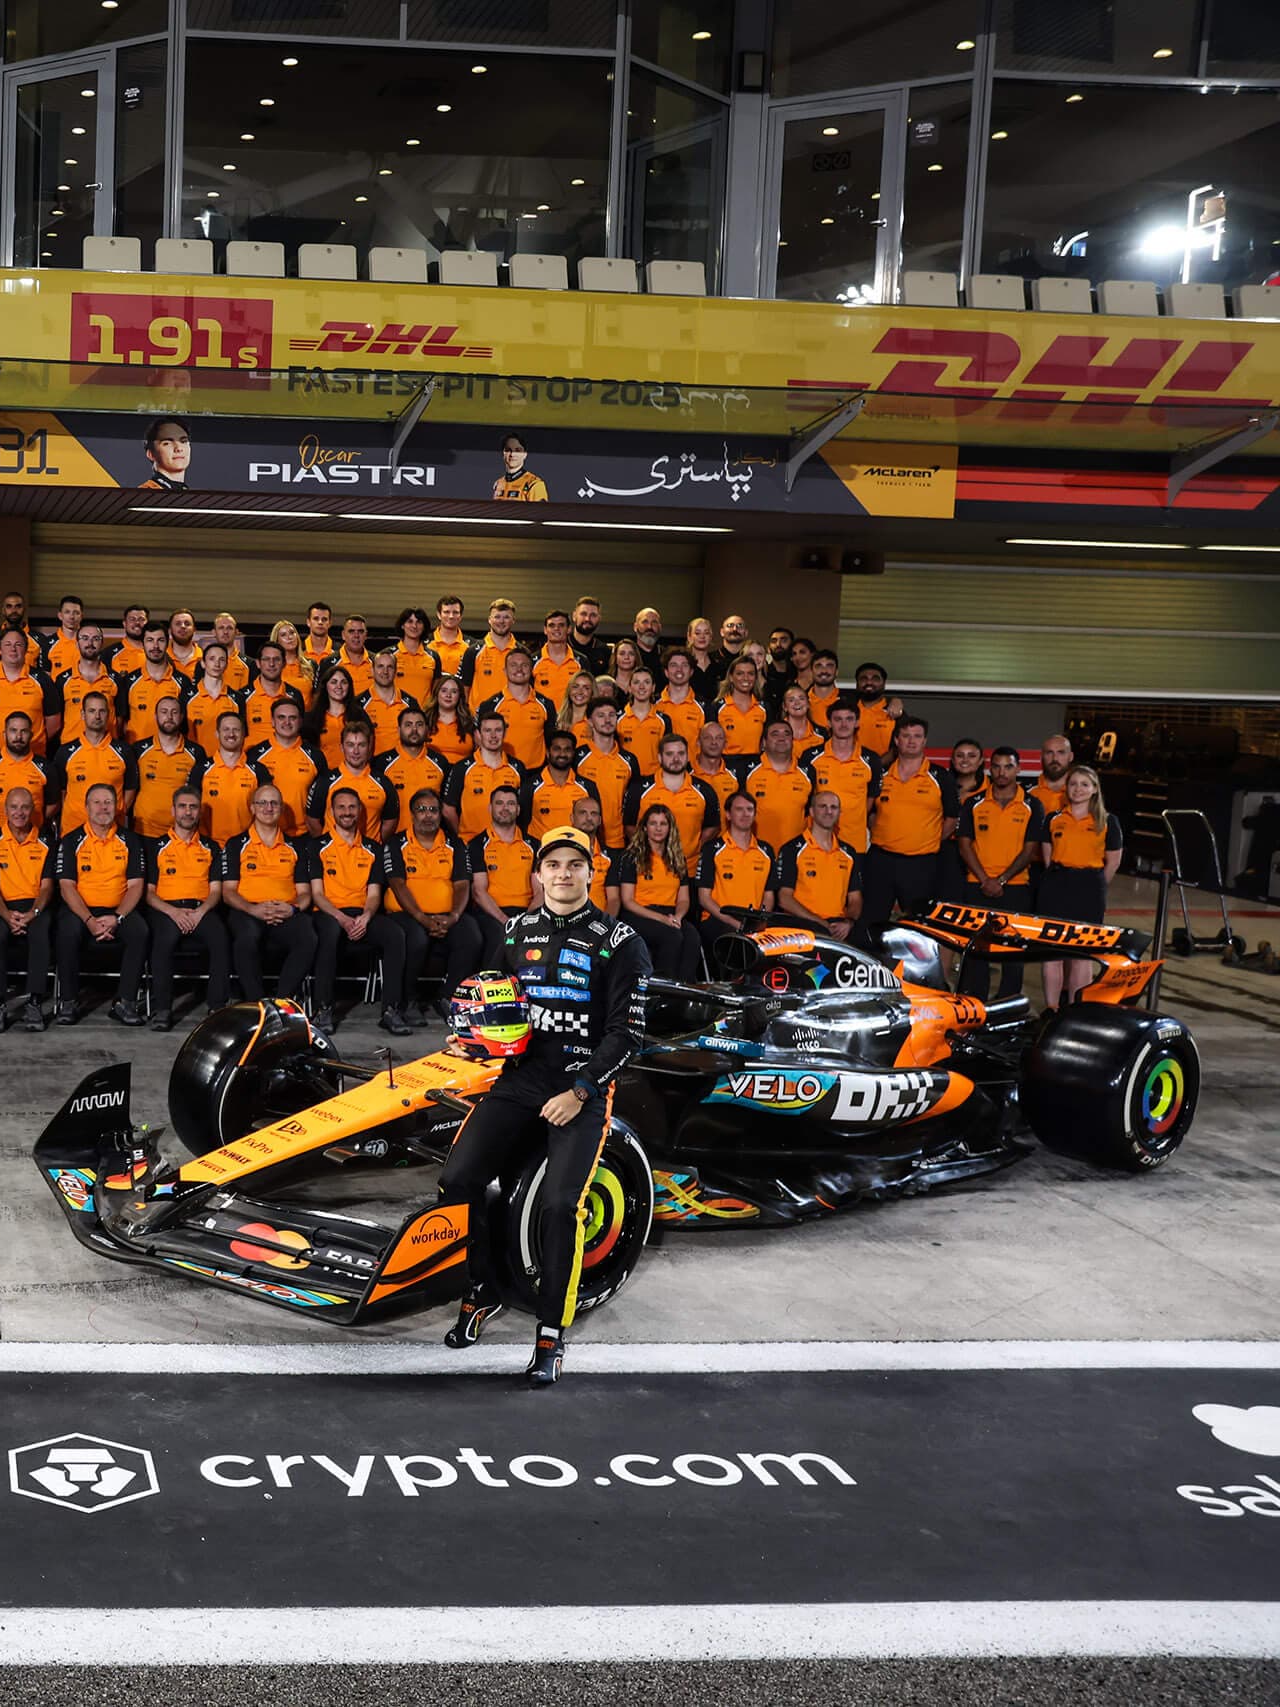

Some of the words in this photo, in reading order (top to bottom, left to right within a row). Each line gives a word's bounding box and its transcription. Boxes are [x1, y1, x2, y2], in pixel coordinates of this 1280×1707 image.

[315, 321, 465, 358] DHL
[870, 328, 1273, 423] DHL
[442, 373, 494, 399] PIT
[508, 376, 592, 404] STOP
[298, 434, 361, 467] Oscar
[249, 463, 435, 486] PIASTRI
[863, 467, 932, 478] McLaren
[523, 935, 550, 943] Android
[486, 988, 513, 998] OKX
[705, 1037, 739, 1051] allwyn
[796, 1039, 820, 1051] cisco
[422, 1061, 456, 1074] allwyn
[728, 1072, 821, 1101] VELO
[241, 1137, 273, 1154] FxPro
[58, 1174, 89, 1201] VELO
[411, 1226, 461, 1245] workday
[214, 1269, 297, 1300] VELO
[199, 1445, 857, 1498] crypto.com
